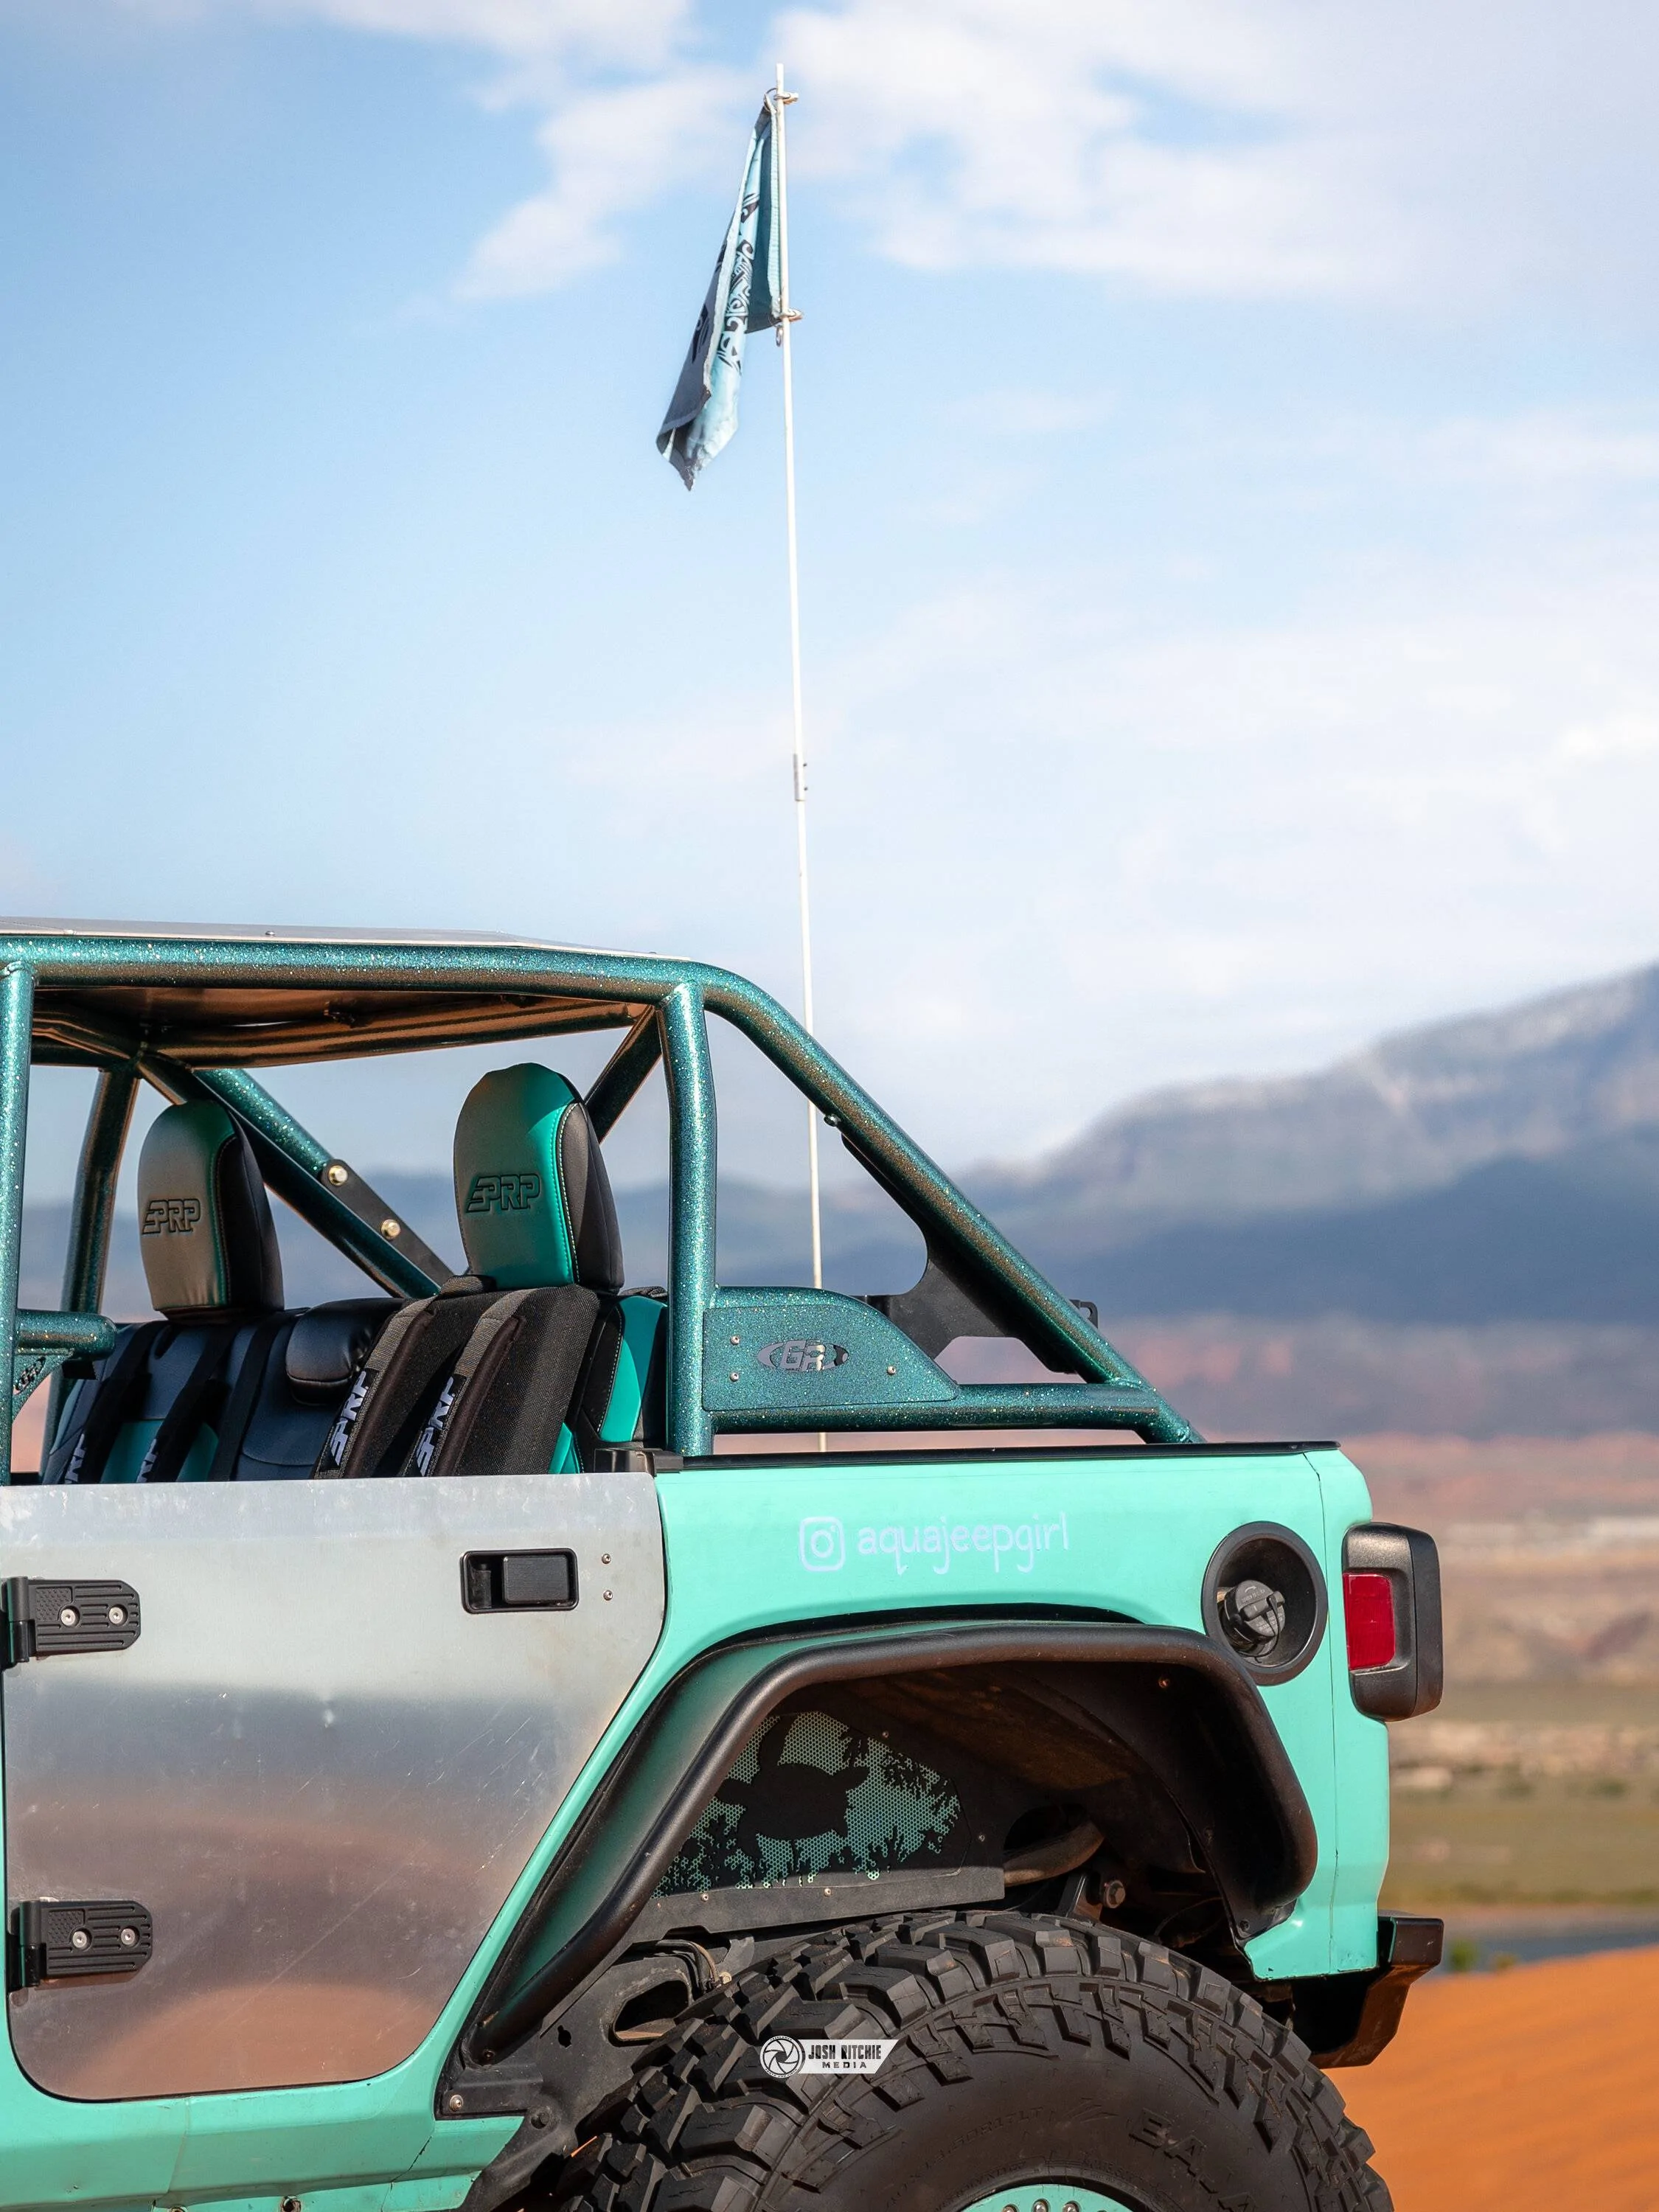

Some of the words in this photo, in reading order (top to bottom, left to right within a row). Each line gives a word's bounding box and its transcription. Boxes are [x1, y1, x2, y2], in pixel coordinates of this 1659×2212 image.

[465, 1173, 540, 1213] PRP
[142, 1198, 201, 1234] PRP
[858, 1511, 1070, 1576] aquajeepgirl
